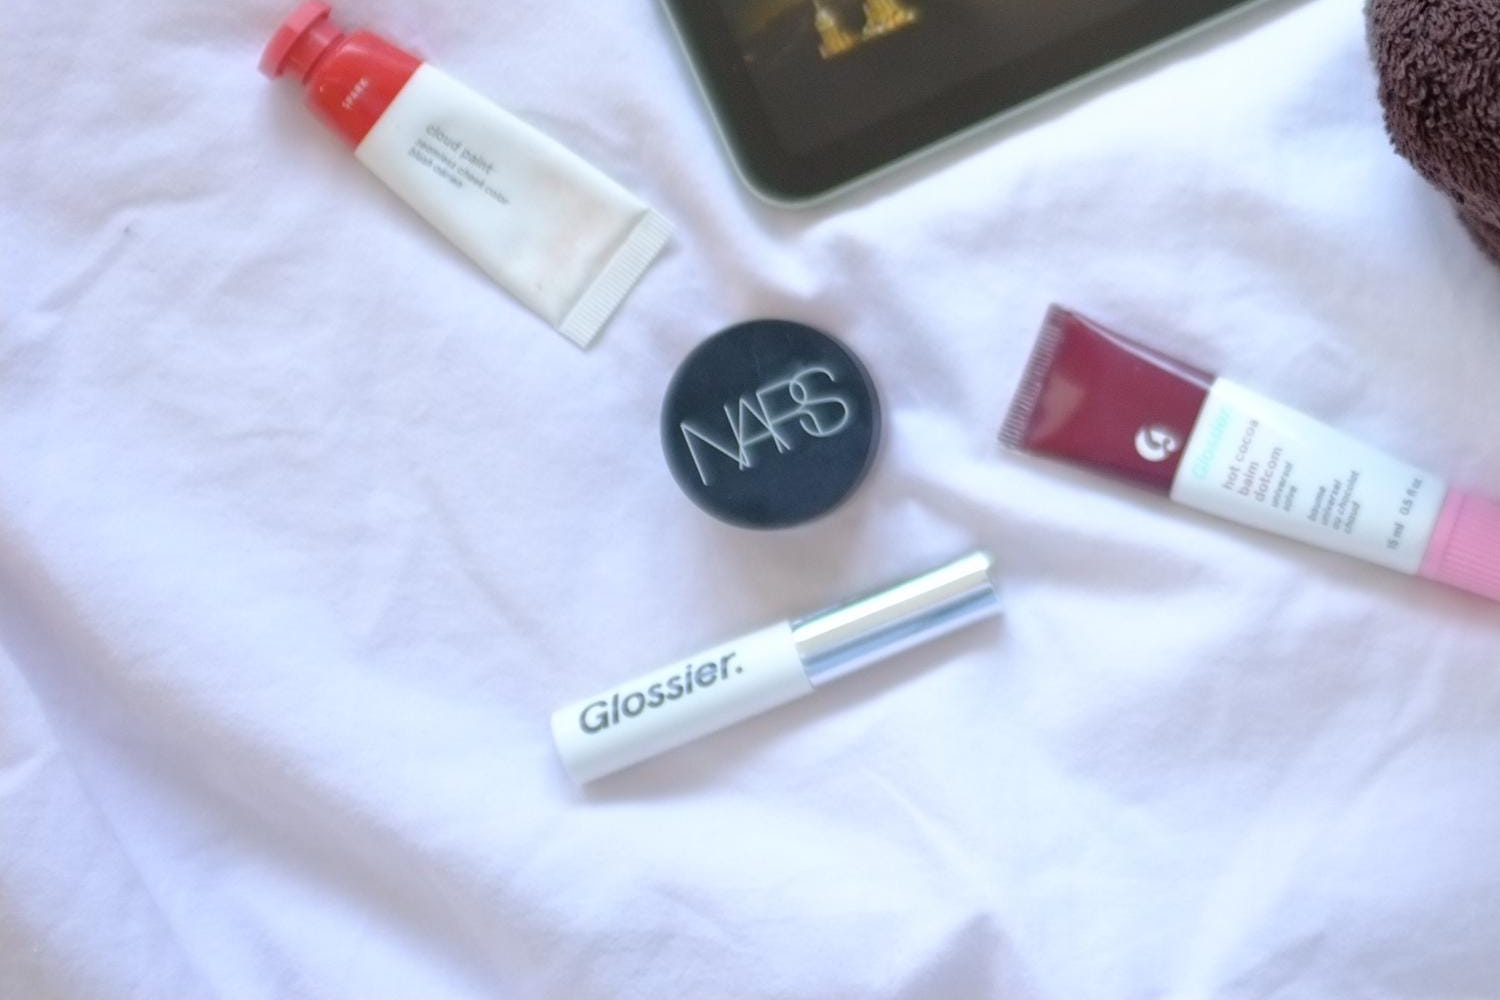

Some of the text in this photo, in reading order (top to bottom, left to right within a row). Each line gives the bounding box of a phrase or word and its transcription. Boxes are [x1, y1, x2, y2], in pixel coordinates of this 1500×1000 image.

[426, 124, 494, 175] cloud paint
[679, 367, 850, 487] NARS
[1222, 419, 1260, 490] hot cocoa
[1253, 447, 1283, 503] dotcom
[1237, 461, 1260, 497] balm
[1272, 460, 1294, 509] universal
[1283, 485, 1299, 512] salve
[1338, 470, 1360, 516] chocolat
[1306, 485, 1326, 522] baume
[1344, 500, 1361, 535] chaud
[1399, 497, 1414, 516] 0.5
[1386, 538, 1400, 551] 15
[1392, 522, 1405, 539] ml
[579, 651, 744, 735] Glossier.
